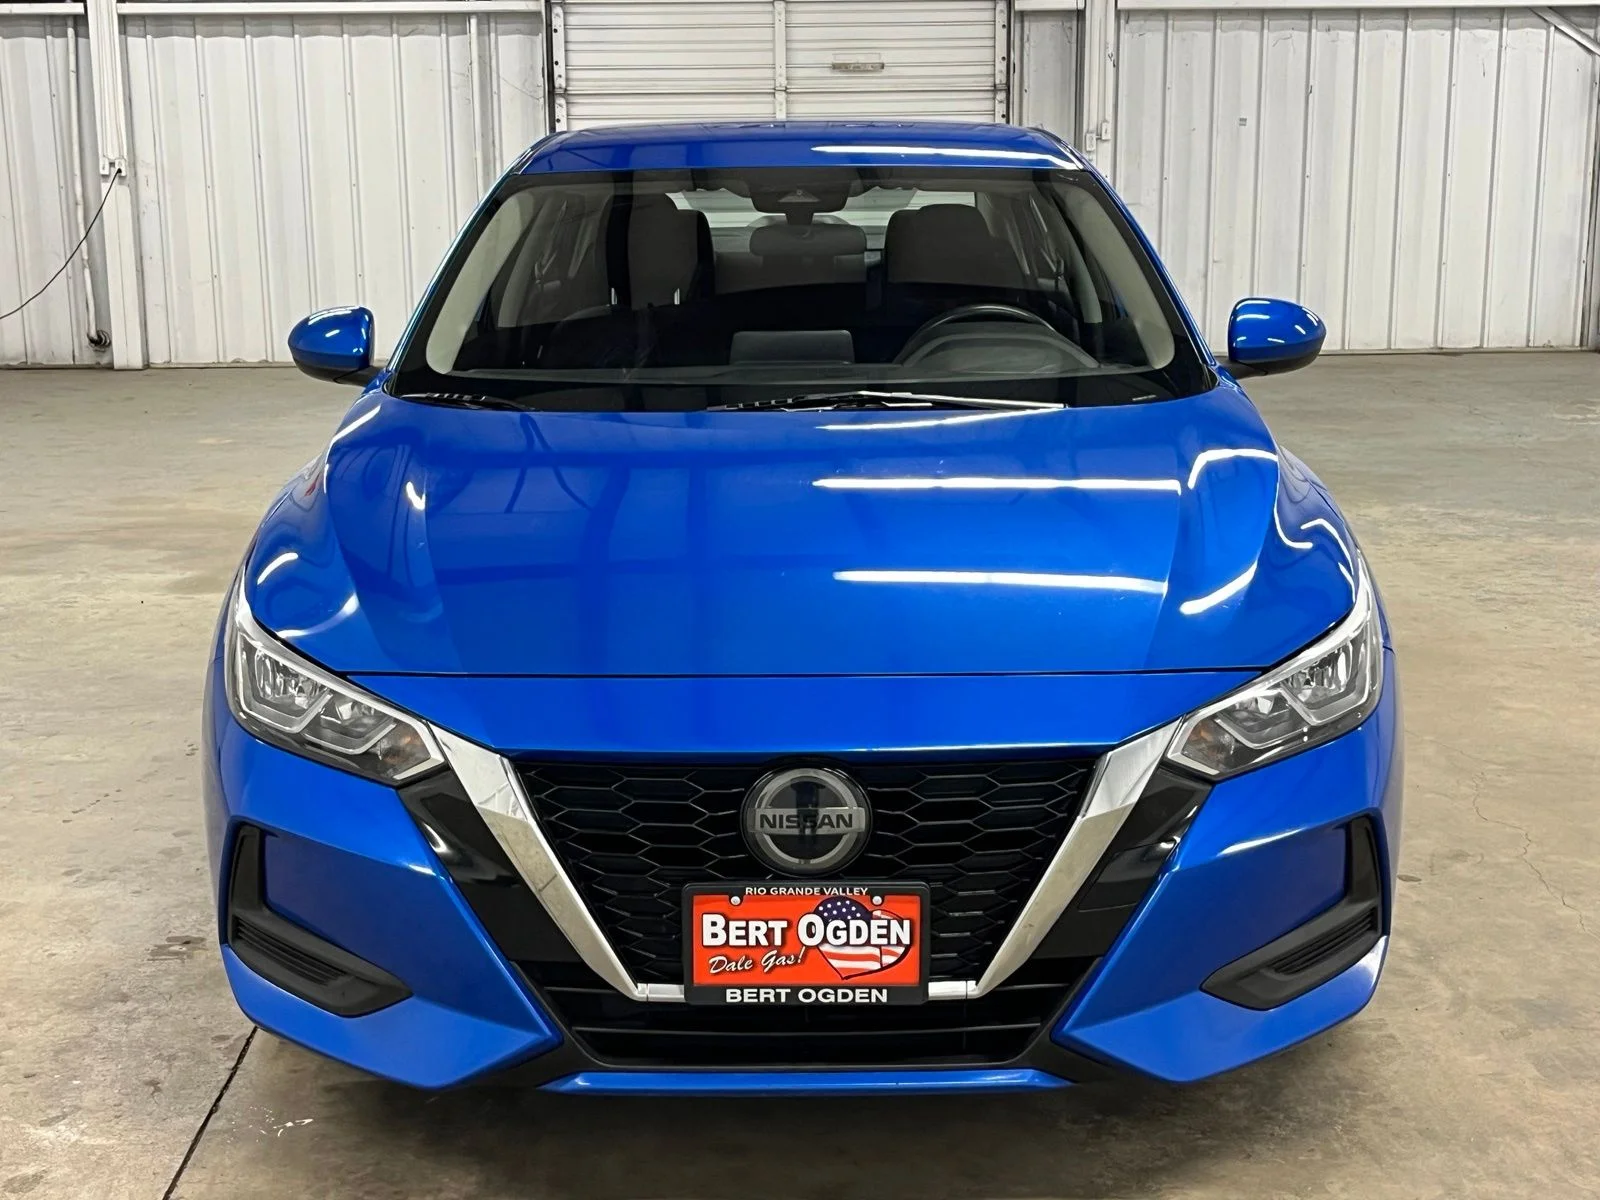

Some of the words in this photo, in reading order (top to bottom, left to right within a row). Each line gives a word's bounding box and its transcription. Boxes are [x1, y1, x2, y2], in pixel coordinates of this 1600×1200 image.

[759, 813, 853, 829] NISSAN
[745, 887, 767, 896] RIO
[770, 887, 820, 896] GRANDE
[822, 887, 868, 896] VALLEY
[702, 913, 788, 947] BERT
[797, 913, 911, 947] OGDEN
[709, 955, 754, 974] Dale
[761, 946, 806, 973] Gas!
[725, 988, 791, 1003] BERT
[798, 988, 888, 1003] OGDEN
